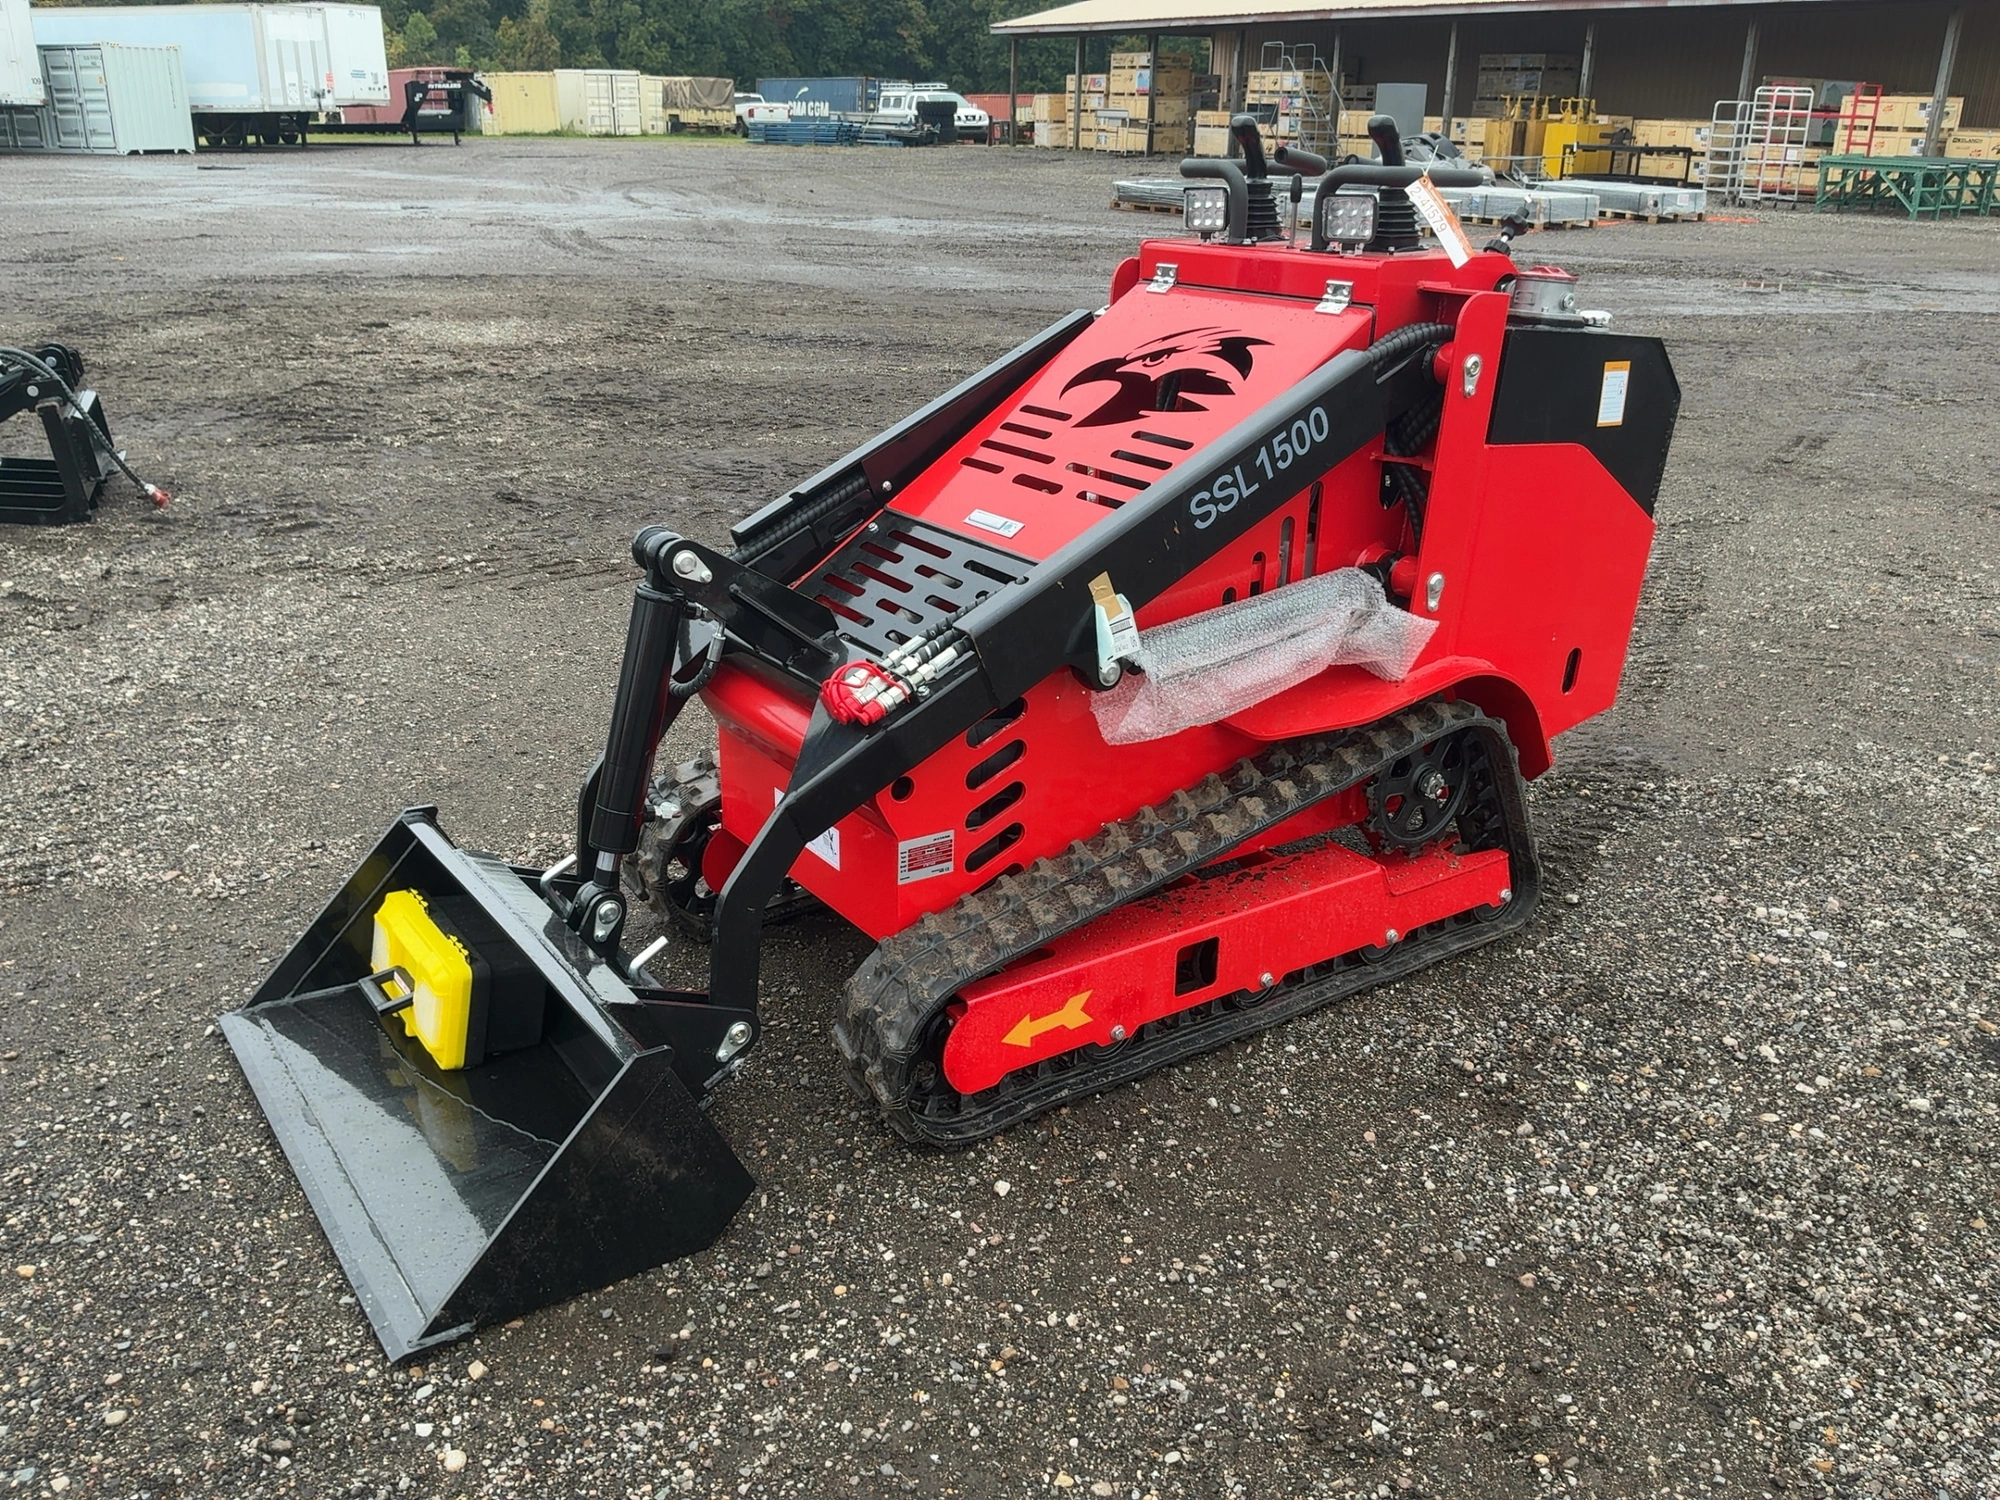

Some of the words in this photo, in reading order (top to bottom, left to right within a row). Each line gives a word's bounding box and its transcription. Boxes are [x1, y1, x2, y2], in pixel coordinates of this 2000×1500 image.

[788, 100, 807, 116] CMA
[807, 101, 830, 117] CGM
[1409, 186, 1448, 233] 2-41579
[1189, 465, 1260, 530] SSL
[1255, 406, 1329, 480] 1500
